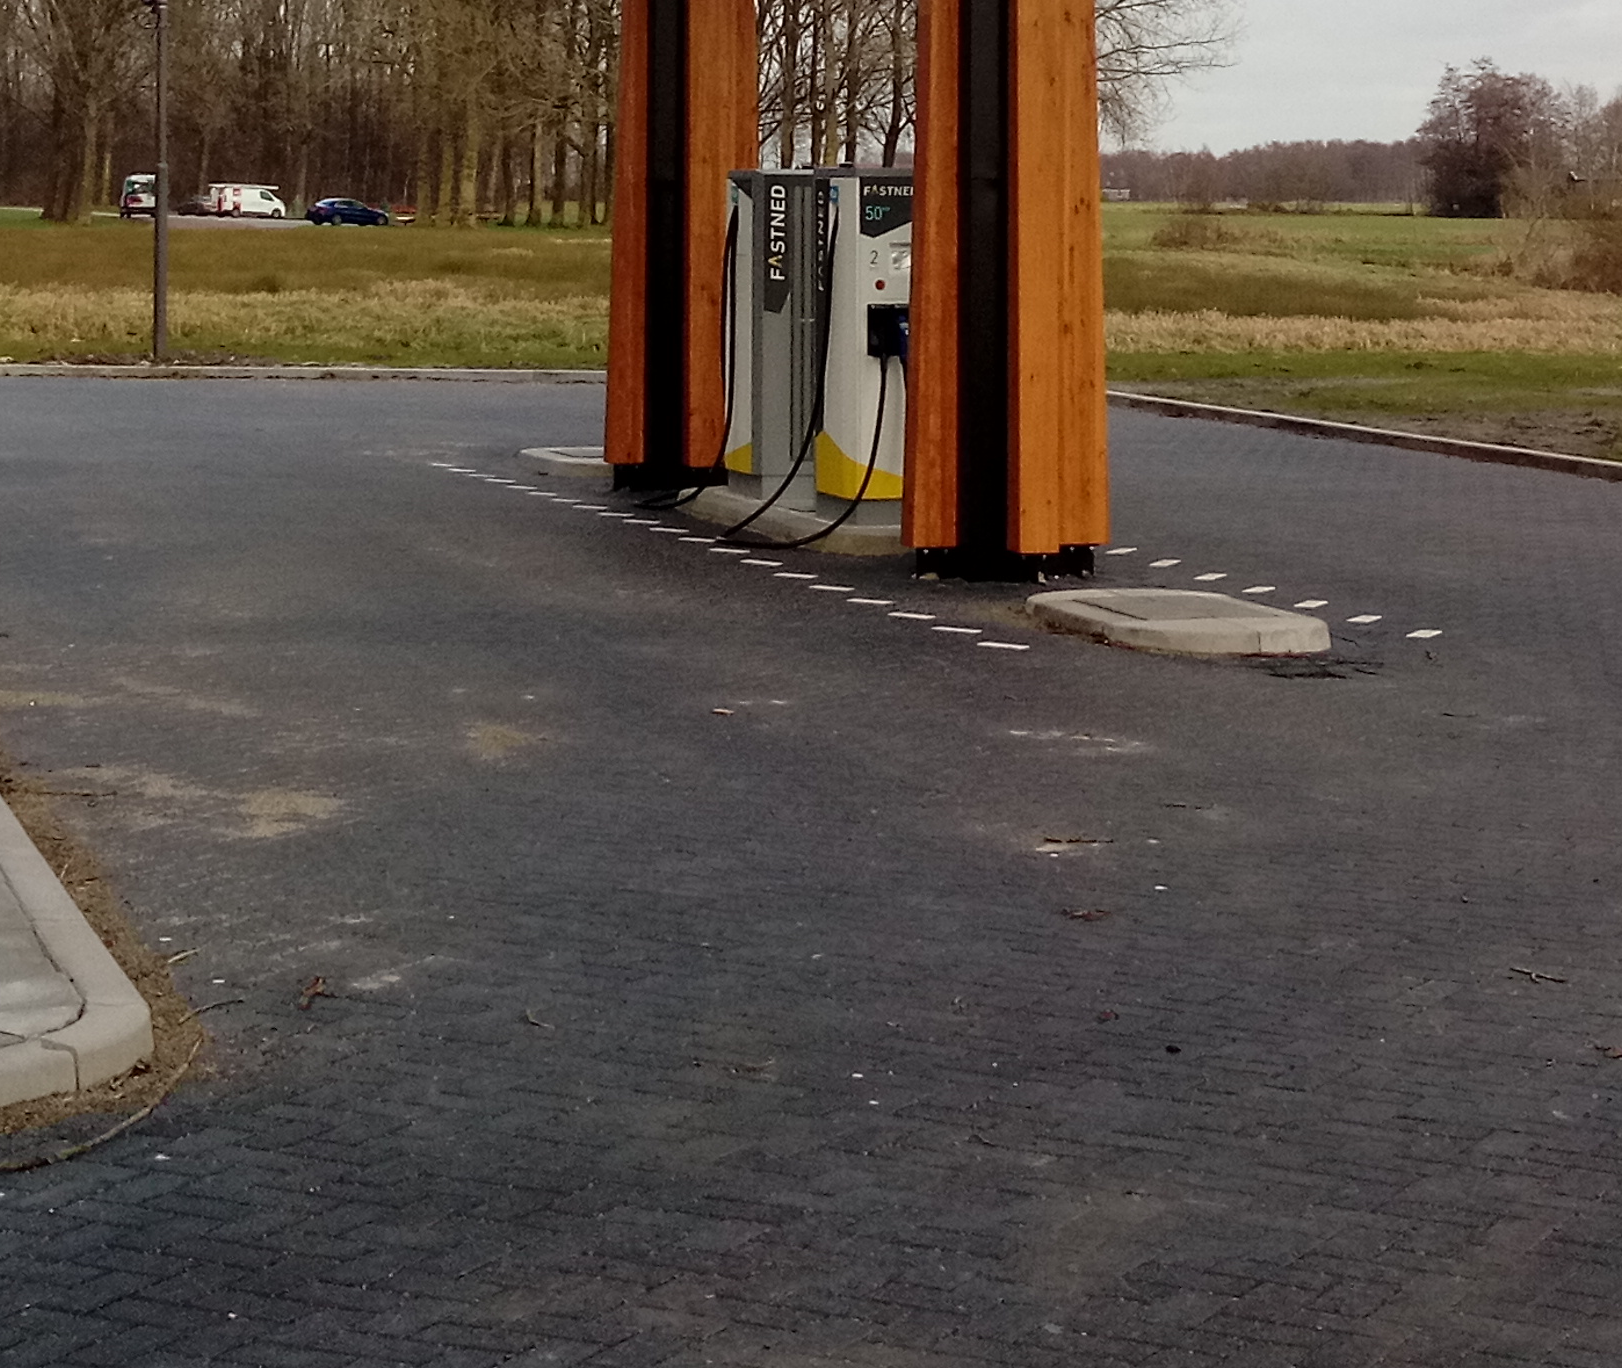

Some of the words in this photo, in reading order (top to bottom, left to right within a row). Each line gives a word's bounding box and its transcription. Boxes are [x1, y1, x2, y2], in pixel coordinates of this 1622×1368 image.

[865, 206, 883, 220] 50
[768, 185, 786, 281] FASTNED
[869, 250, 879, 265] 2
